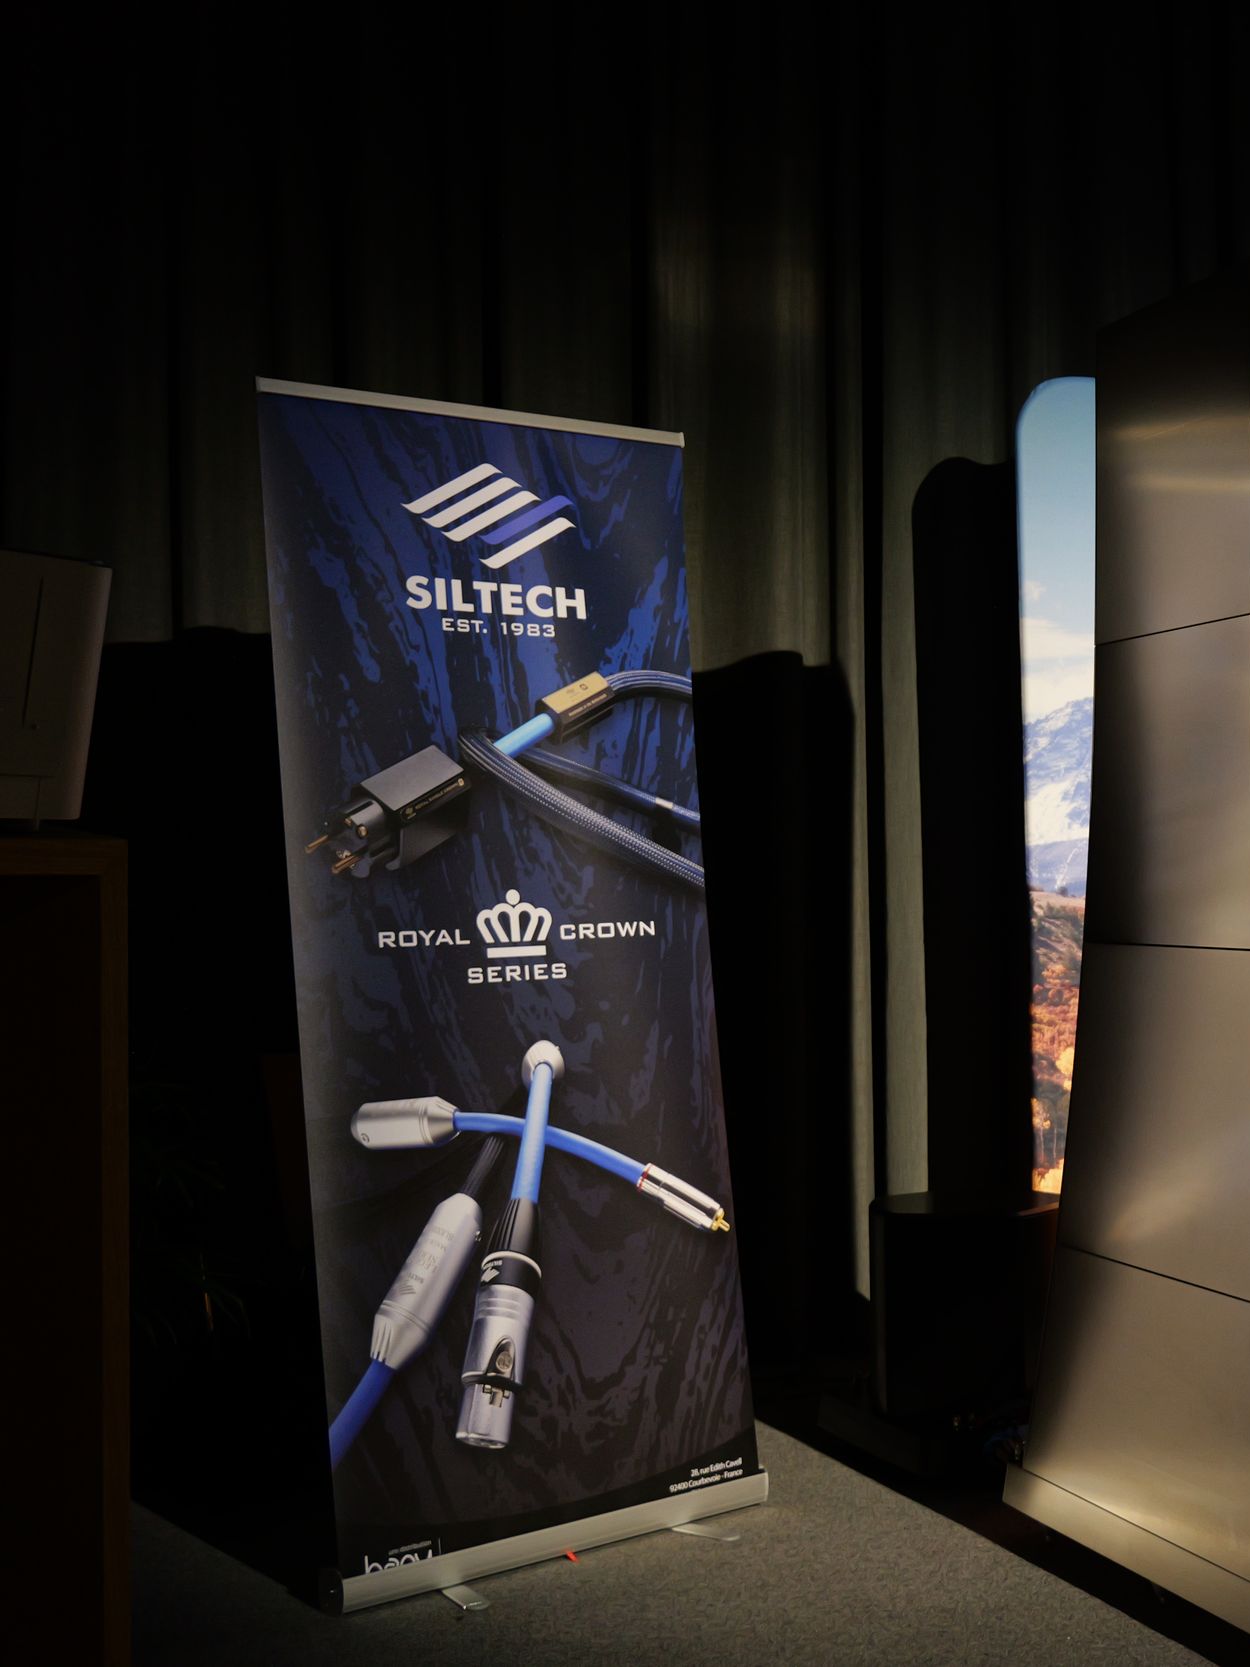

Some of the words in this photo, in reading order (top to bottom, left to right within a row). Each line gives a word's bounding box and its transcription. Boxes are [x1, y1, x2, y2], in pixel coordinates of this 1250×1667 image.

[405, 574, 588, 620] SILTECH
[441, 617, 488, 634] EST.
[500, 621, 556, 638] 1983
[377, 928, 471, 949] ROYAL
[559, 920, 656, 941] CROWN
[467, 962, 568, 984] SERIES
[700, 1466, 711, 1474] rue
[724, 1469, 744, 1479] France
